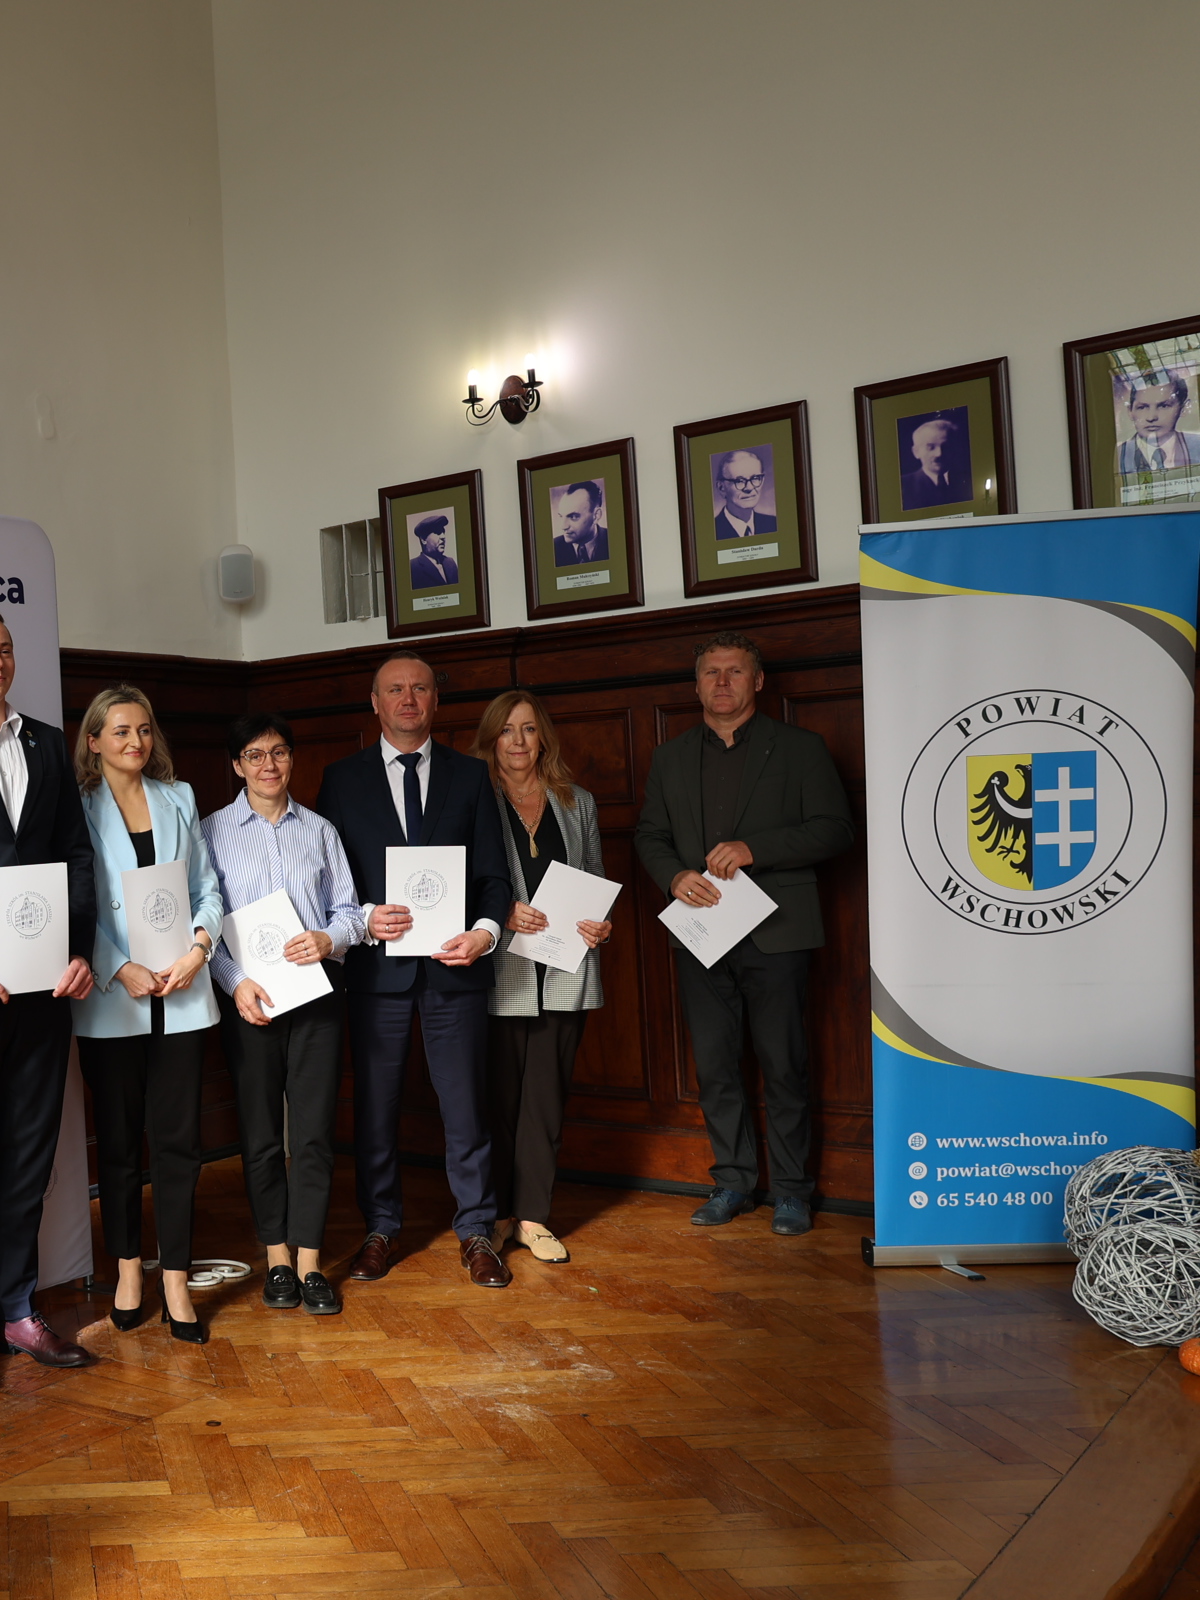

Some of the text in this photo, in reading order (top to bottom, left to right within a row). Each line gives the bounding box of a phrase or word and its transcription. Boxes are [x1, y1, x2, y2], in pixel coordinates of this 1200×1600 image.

[953, 695, 1119, 739] POWIAT
[939, 869, 1133, 930] WSCHOWSKI
[936, 1130, 1108, 1148] www.wschowa.info
[936, 1191, 1054, 1207] 65 540 48 00
